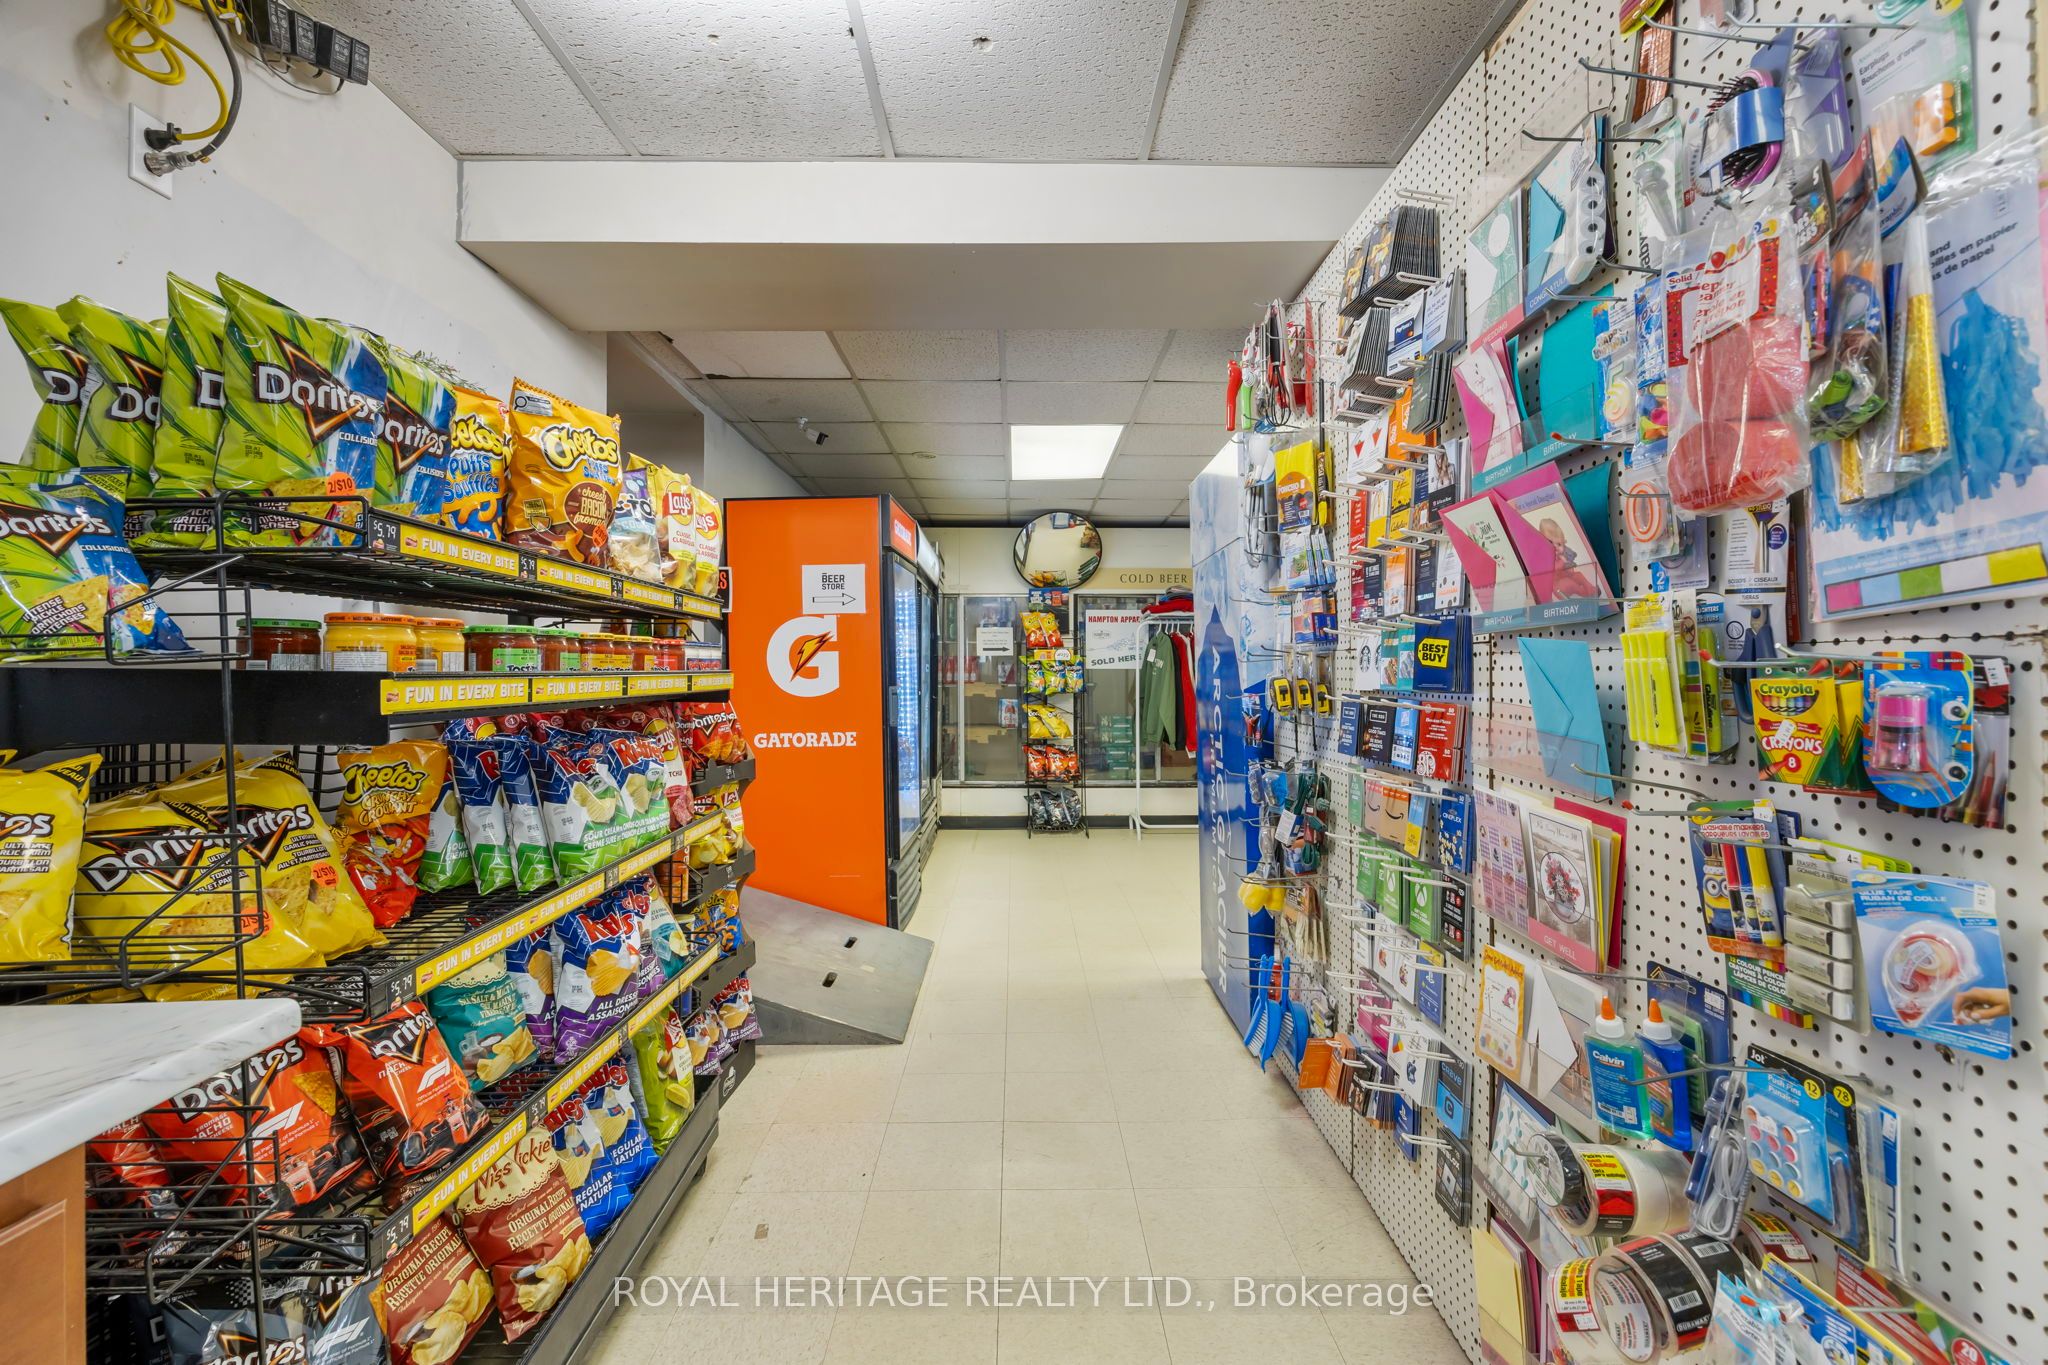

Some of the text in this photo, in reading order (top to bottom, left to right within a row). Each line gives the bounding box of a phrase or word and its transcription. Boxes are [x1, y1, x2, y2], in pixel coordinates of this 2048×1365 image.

[1959, 222, 2018, 255] en papier
[1944, 244, 1996, 275] de papel
[1669, 273, 1694, 285] Solid
[256, 363, 384, 420] Doritos
[543, 428, 618, 470] Cheetos
[449, 454, 491, 479] Puffs
[1484, 464, 1513, 485] BIRTHDAY
[669, 492, 693, 517] Lay's
[373, 520, 397, 539] $5.79
[80, 544, 131, 553] COLLISIONS
[421, 536, 515, 571] FUN IN EVERY BITE
[520, 556, 535, 571] $5.79
[549, 569, 610, 590] FUN IN EVERY BITE
[821, 583, 845, 591] STORE
[822, 574, 845, 583] BEER
[1119, 573, 1188, 584] COLD BEER
[1483, 614, 1514, 627] BIRTHDAY
[1543, 604, 1580, 619] BIRTHDAY
[766, 615, 839, 697] G
[1421, 643, 1448, 655] BEST
[1421, 652, 1445, 664] BUY
[1091, 657, 1115, 666] SOLD
[405, 682, 525, 704] FUN IN EVERY BITE
[547, 680, 621, 697] FUN IN EVERY BITE
[1759, 682, 1815, 698] Crayola
[1208, 644, 1226, 801] ARCTIC
[753, 731, 857, 748] GATORADE
[1761, 736, 1824, 755] CRAYONS
[1787, 756, 1797, 768] 8
[343, 762, 426, 803] Cheetos
[358, 801, 417, 826] CROQUANT
[583, 830, 603, 843] SOUR
[540, 880, 604, 918] FUN IN EVERY BITE
[1215, 815, 1229, 995] GLACIER
[436, 920, 526, 976] FUN IN EVERY BITE
[1542, 934, 1577, 961] GET WELL
[1728, 962, 1757, 978] CRAYONS
[1736, 959, 1763, 974] COLOUR
[391, 975, 413, 995] $5.79
[1757, 980, 1767, 988] DE
[597, 1001, 614, 1011] ALL
[1592, 1049, 1625, 1068] Calvin
[1751, 1049, 1765, 1064] Jot
[559, 1077, 574, 1091] FUN
[575, 1067, 583, 1077] IN
[583, 1050, 602, 1073] EVERY
[1767, 1073, 1802, 1097] Push Pins
[1806, 1081, 1818, 1096] 12
[1835, 1087, 1850, 1103] 78
[433, 1119, 523, 1206] FUN IN EVERY BITE
[575, 1171, 613, 1206] REGULAR
[579, 1182, 614, 1212] NATURE
[508, 1187, 567, 1233] ORIGINAL RECIPE
[386, 1215, 410, 1243] $5.79
[507, 1220, 548, 1251] RECETTE
[385, 1226, 452, 1294] ORIGINAL RECIPE
[386, 1231, 464, 1311] RECETTE ORIGINALE
[1961, 1343, 1978, 1362] 20
